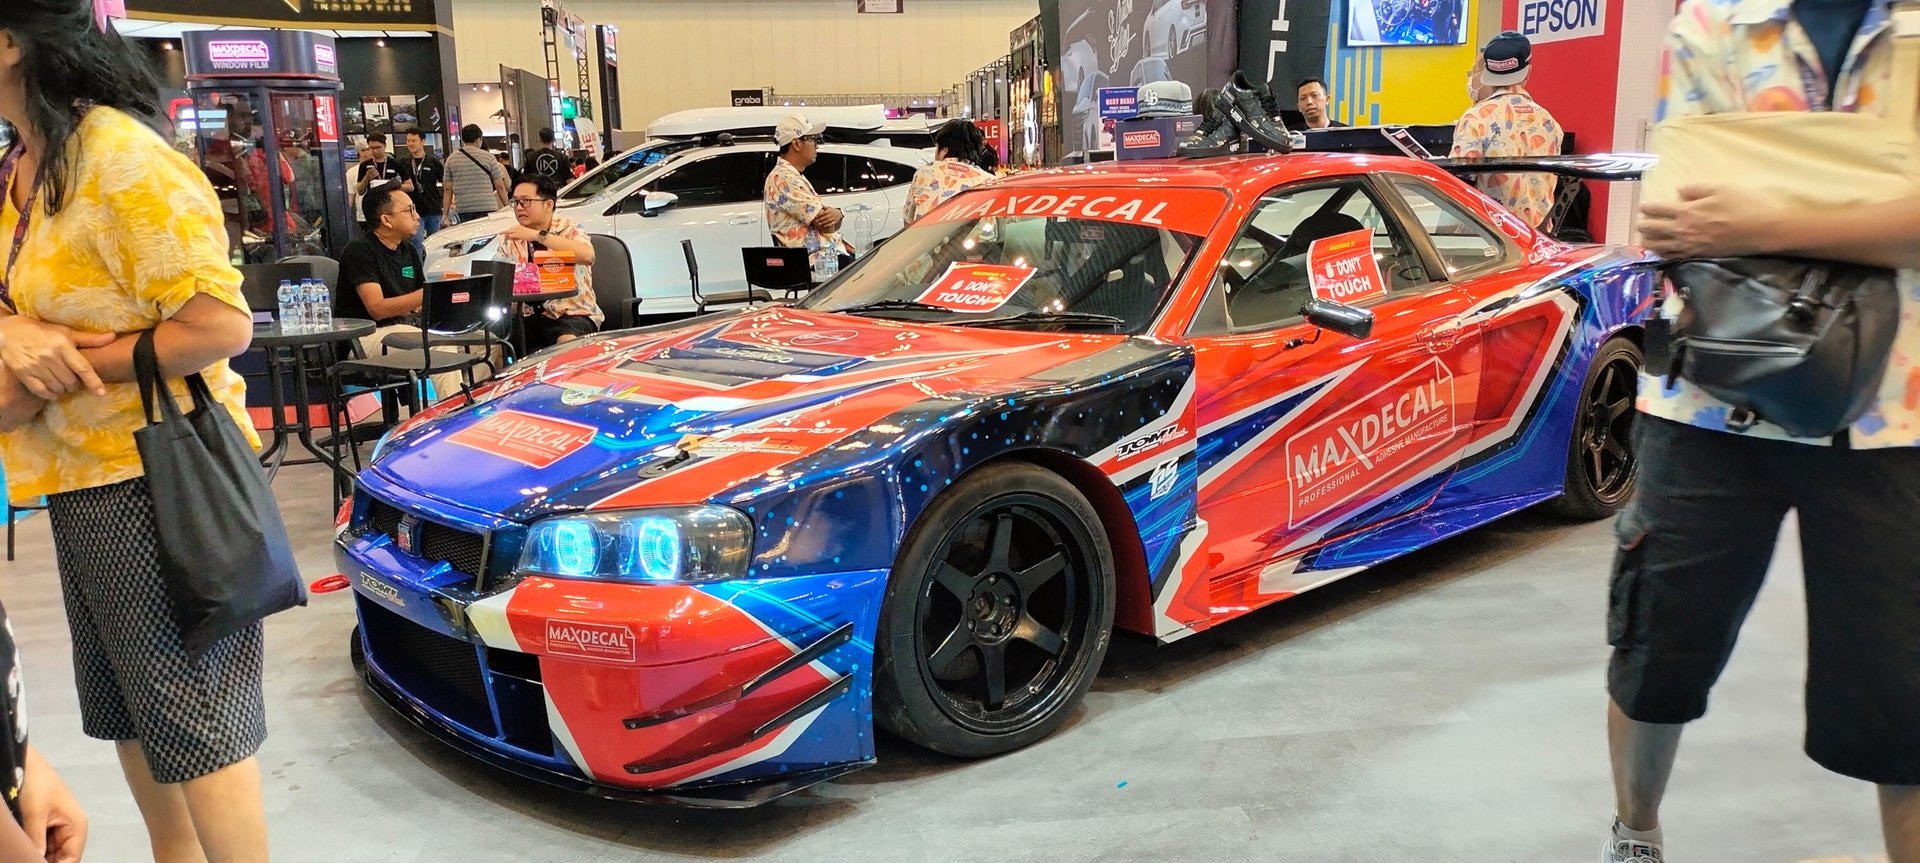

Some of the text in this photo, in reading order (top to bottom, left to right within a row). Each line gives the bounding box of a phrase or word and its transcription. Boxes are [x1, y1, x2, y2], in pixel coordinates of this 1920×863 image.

[1523, 0, 1597, 36] EPSON
[213, 61, 269, 69] WINDOW FILM
[734, 96, 761, 107] grebe
[1125, 132, 1159, 145] MAXDECAL
[938, 194, 1169, 226] MAXDECAL
[1335, 256, 1362, 276] DON'T
[936, 292, 993, 306] TOUCH
[1327, 275, 1372, 299] TOUCH
[479, 416, 580, 452] MAXDECAL
[1294, 378, 1445, 489] MAXDECAL
[1298, 413, 1449, 508] PROFESSIONAL ADHESIVE MANUFACTURE
[549, 625, 628, 651] MAXDECAL
